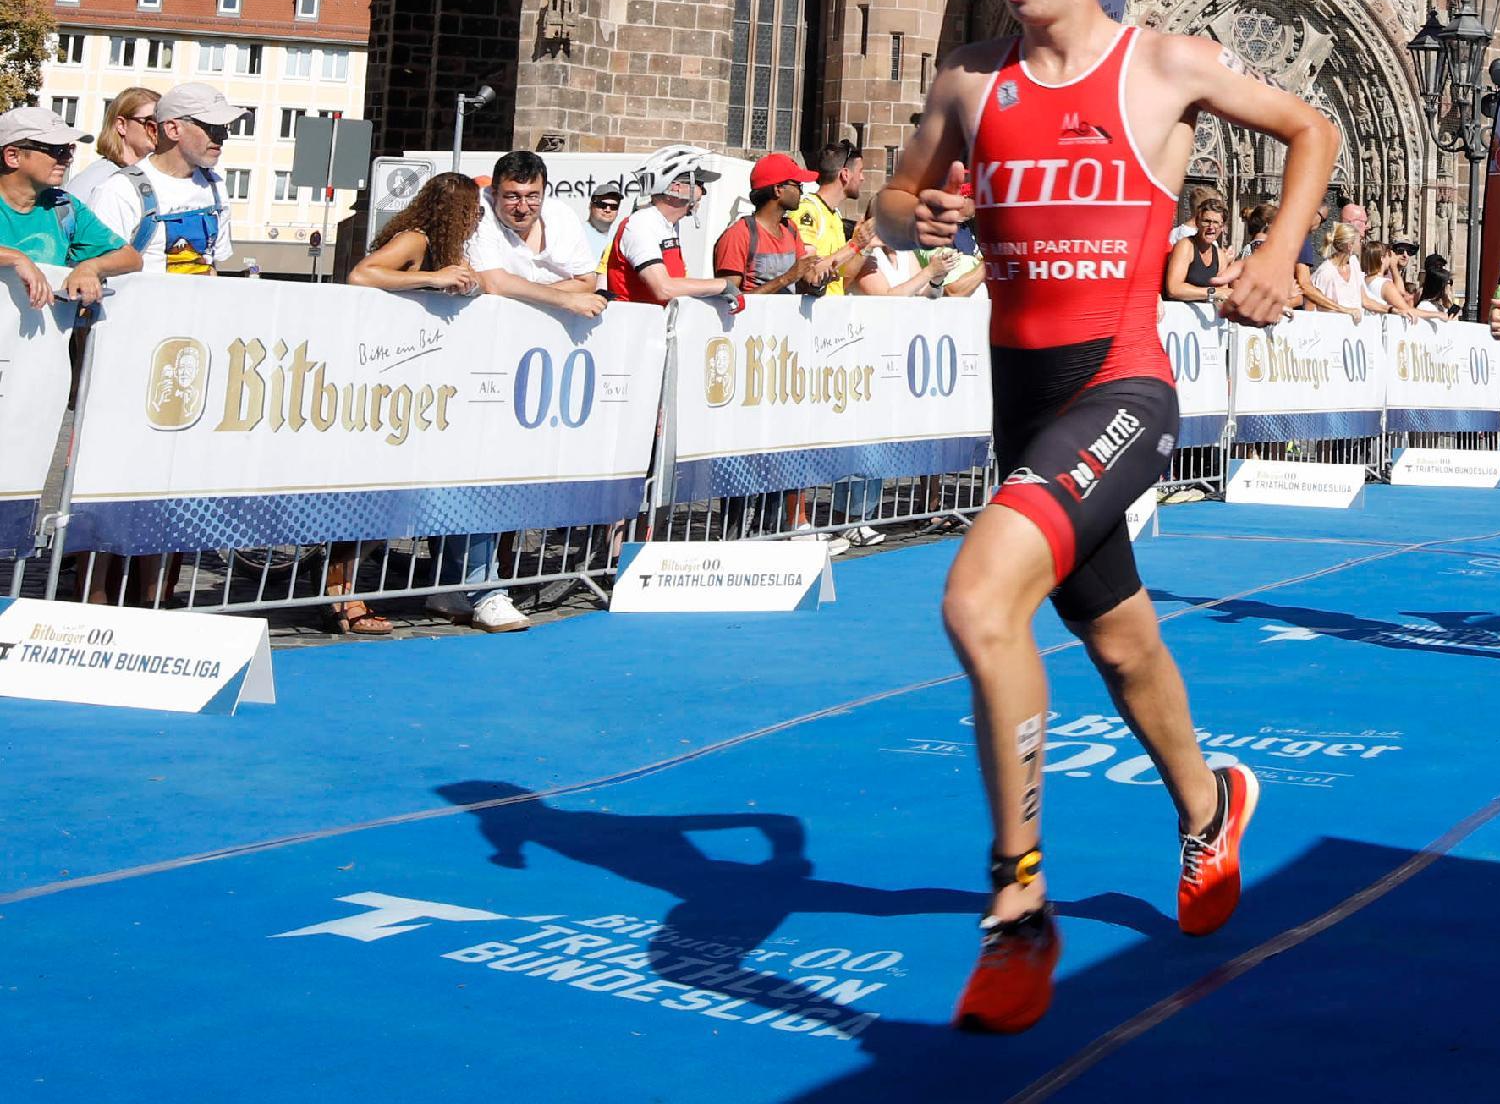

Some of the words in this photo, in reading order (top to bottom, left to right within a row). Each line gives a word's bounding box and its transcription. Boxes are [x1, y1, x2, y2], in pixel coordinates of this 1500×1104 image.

[1028, 260, 1128, 280] HORN
[1033, 240, 1128, 254] PARTNER
[741, 334, 876, 414] Bitburger
[907, 334, 958, 398] 0.0
[1166, 331, 1200, 383] 0.0
[1265, 335, 1330, 390] Bitburger
[1342, 338, 1367, 383] 0.0
[1410, 342, 1460, 391] Bitburger
[213, 336, 459, 446] Bitburger
[513, 346, 596, 430] 0.0
[1255, 481, 1300, 491] TRIATHLON
[657, 574, 723, 587] TRIATHLON
[726, 573, 803, 587] BUNDESLIGA
[29, 623, 85, 645] Bitburger
[20, 643, 114, 669] TRIATHLON
[114, 653, 222, 679] BUNDESLIGA
[511, 925, 887, 1006] TRIATHLON
[573, 914, 787, 963] Bitburger
[790, 947, 904, 973] 0.0
[440, 941, 881, 1042] BUNDESLIGA
